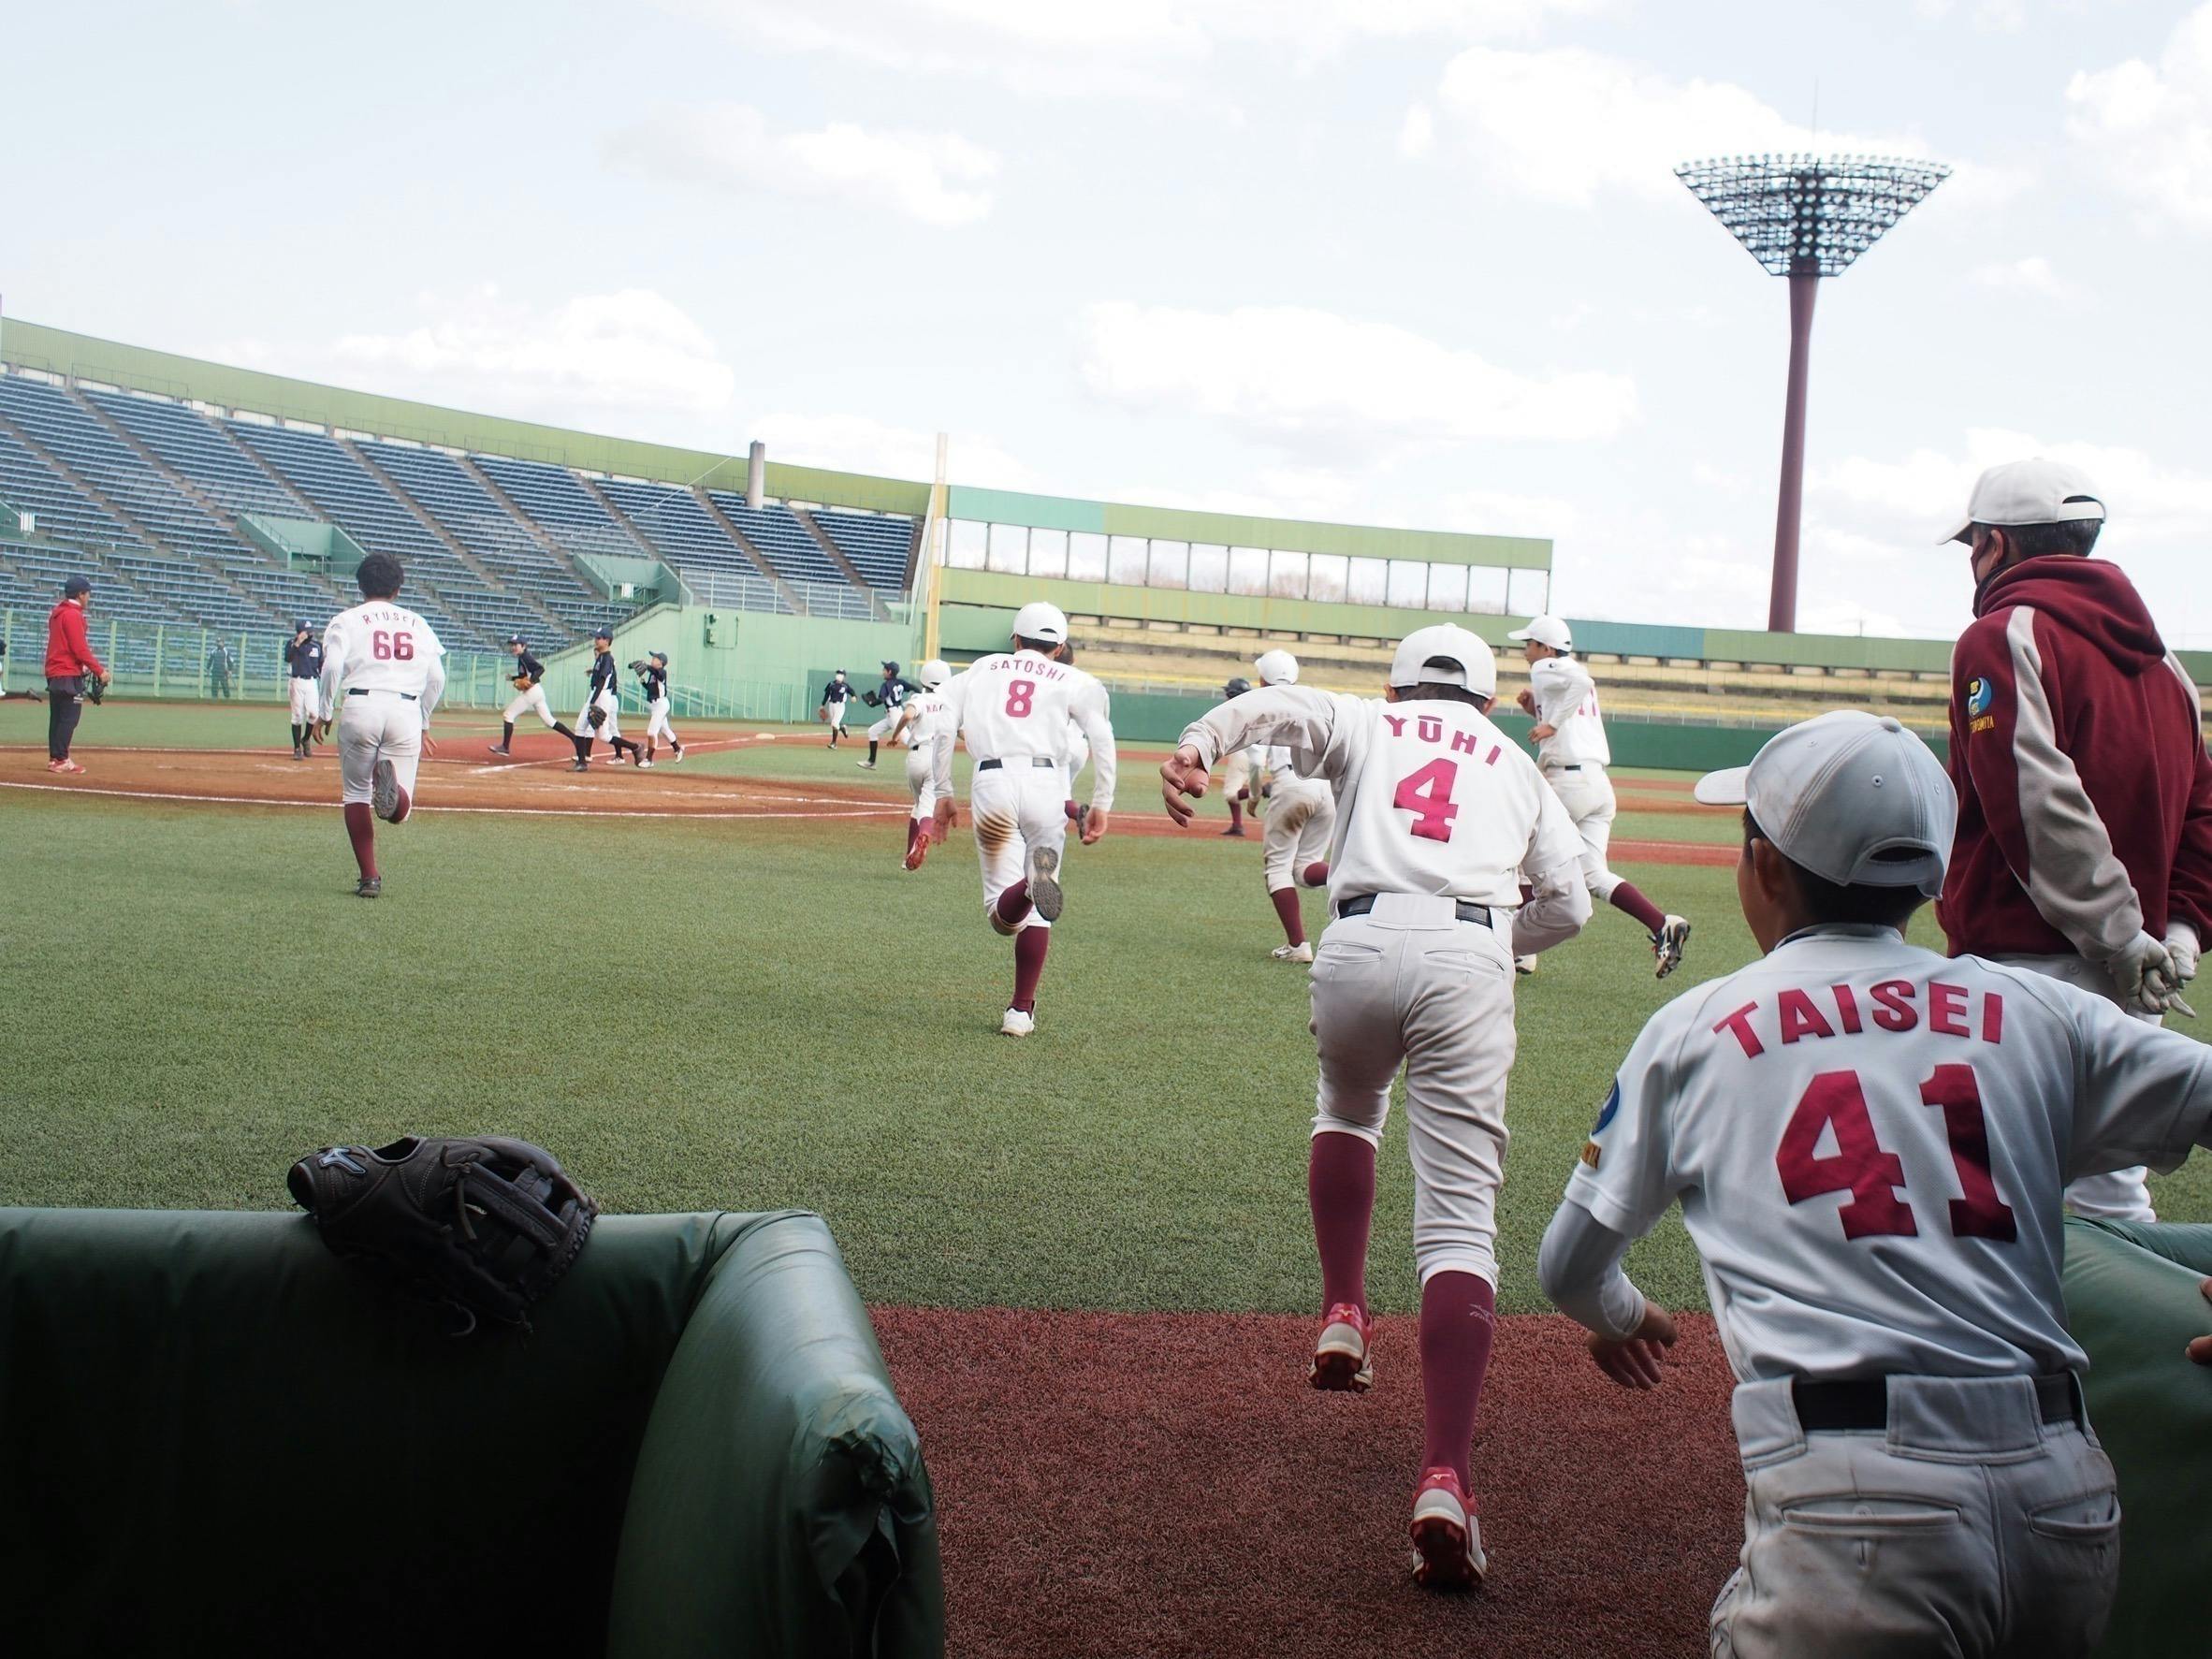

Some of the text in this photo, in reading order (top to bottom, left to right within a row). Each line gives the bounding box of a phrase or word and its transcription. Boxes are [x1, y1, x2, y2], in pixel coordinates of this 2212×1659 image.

[372, 630, 415, 661] 66
[990, 660, 1066, 681] SATOSHI
[1005, 679, 1036, 718] 8
[1392, 757, 1459, 843] 4
[1712, 980, 2003, 1059] TAISEI
[1775, 1063, 2018, 1243] 41
